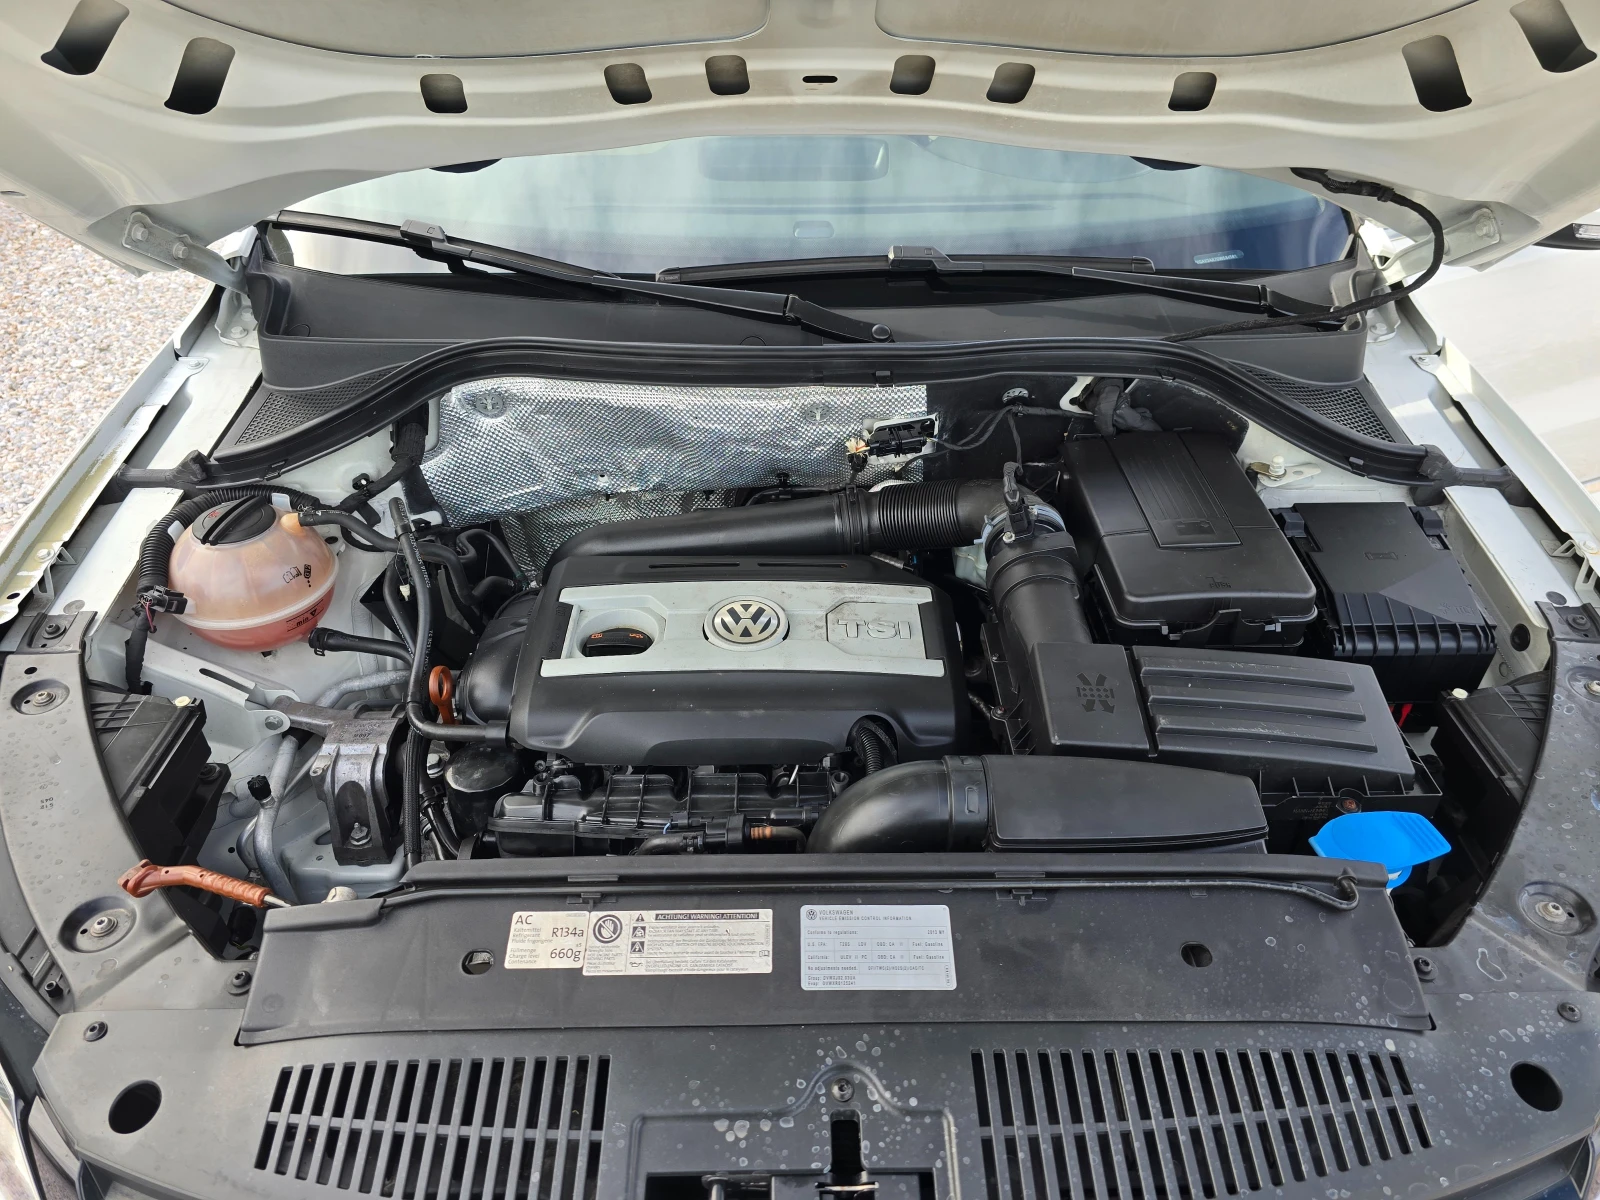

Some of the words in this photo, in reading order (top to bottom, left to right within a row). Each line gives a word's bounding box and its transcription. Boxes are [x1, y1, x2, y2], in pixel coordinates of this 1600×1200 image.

[296, 616, 310, 628] min
[837, 617, 912, 641] TSI
[515, 914, 533, 925] AC
[690, 912, 723, 920] WARNING!
[551, 927, 584, 938] R134a
[550, 948, 582, 963] 660g
